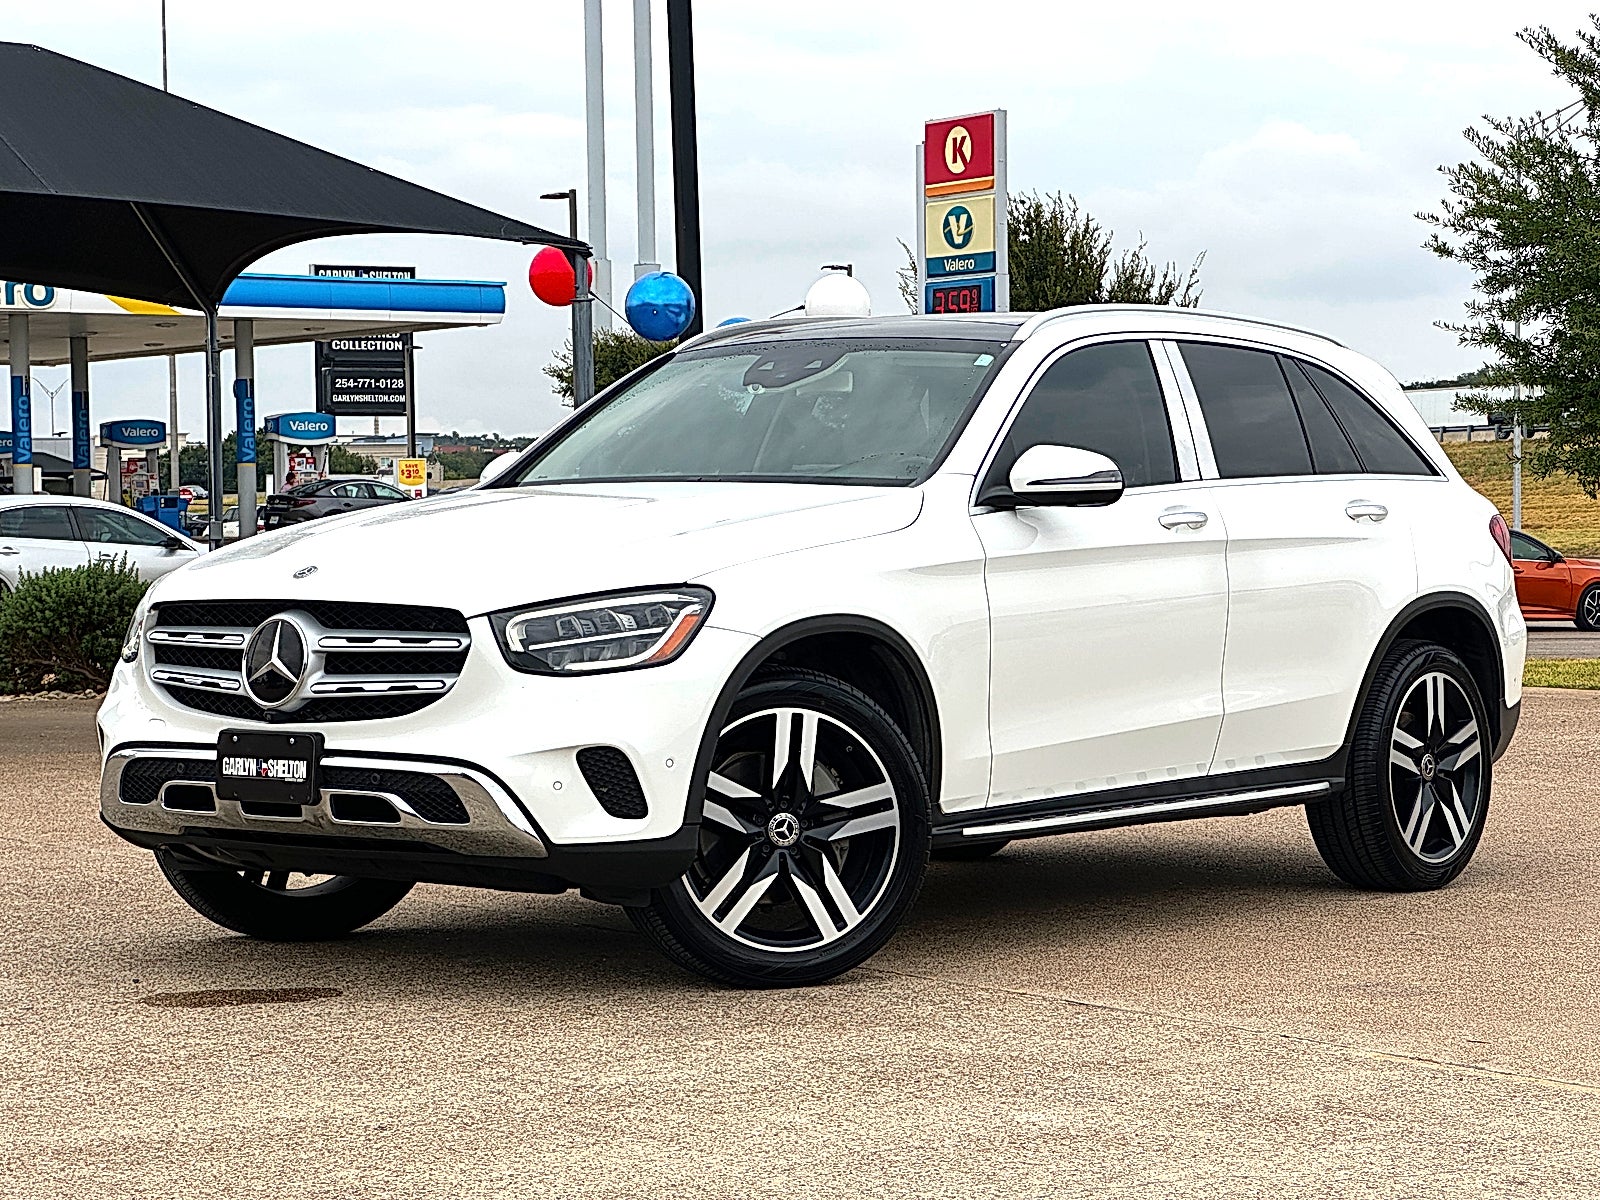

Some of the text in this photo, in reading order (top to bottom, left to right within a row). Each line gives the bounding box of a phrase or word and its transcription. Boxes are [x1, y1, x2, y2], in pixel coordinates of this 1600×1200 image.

[951, 135, 970, 169] K
[943, 257, 975, 272] Valero
[331, 340, 403, 351] COLLECTION
[335, 378, 405, 389] 254-771-0128
[332, 394, 406, 403] GARLYNSHELTON.COM
[16, 396, 31, 463] Valero
[121, 427, 159, 437] Valero
[242, 398, 255, 462] Valero
[289, 420, 328, 431] Valero
[77, 409, 89, 468] Valero
[222, 756, 307, 779] GARLYN SHELTON
